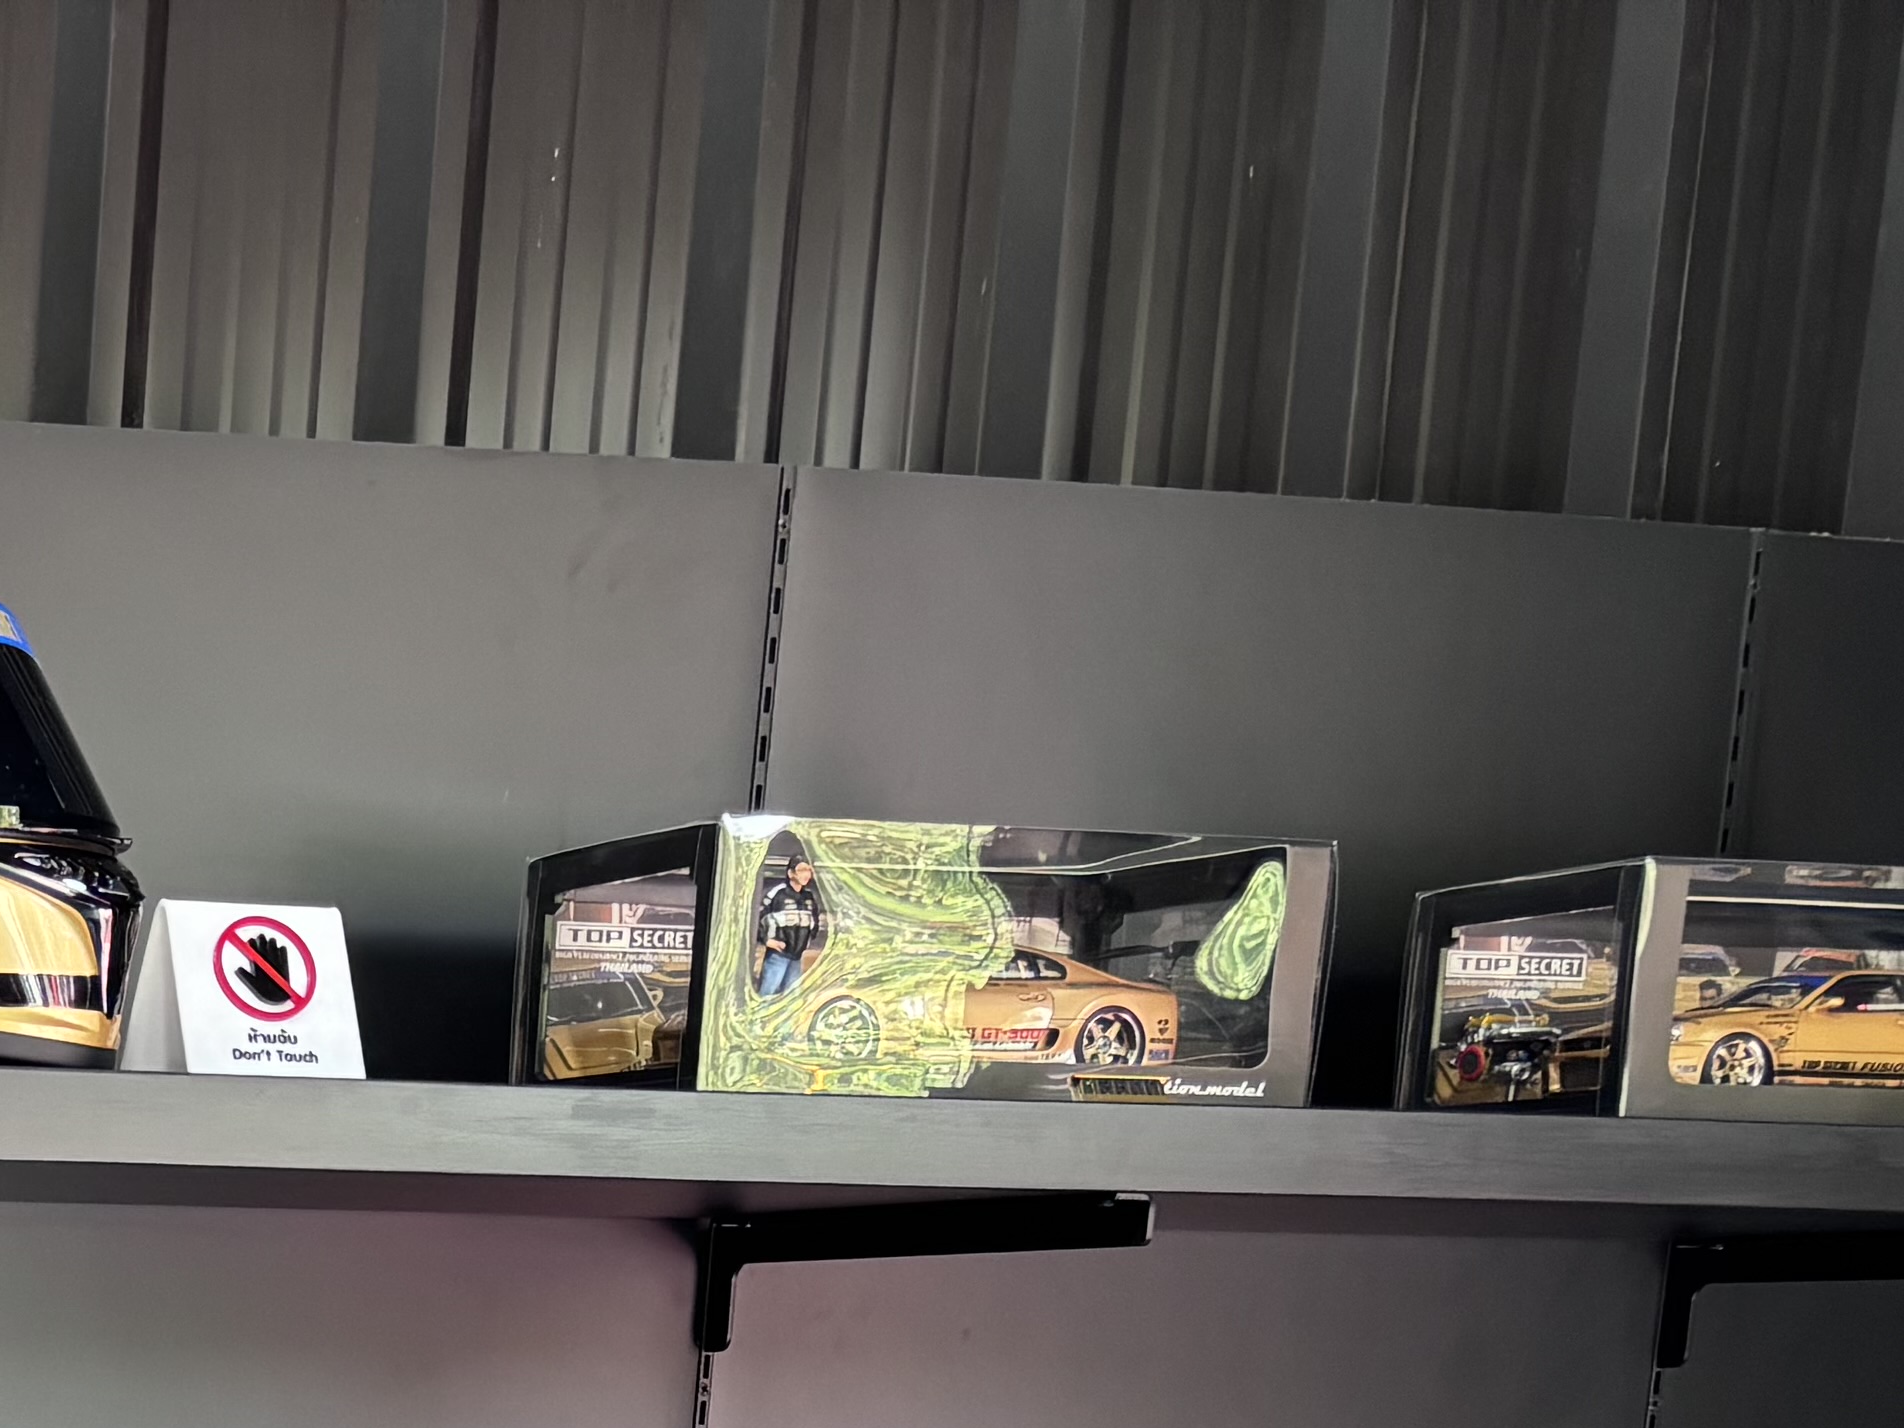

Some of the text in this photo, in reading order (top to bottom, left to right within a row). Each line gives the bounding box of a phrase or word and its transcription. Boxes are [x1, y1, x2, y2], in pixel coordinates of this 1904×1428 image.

[567, 928, 694, 949] TOP SECRET
[1459, 955, 1583, 977] TOP SECRET
[247, 1027, 298, 1046] ห้ามจับ
[232, 1048, 319, 1063] Don't Touch
